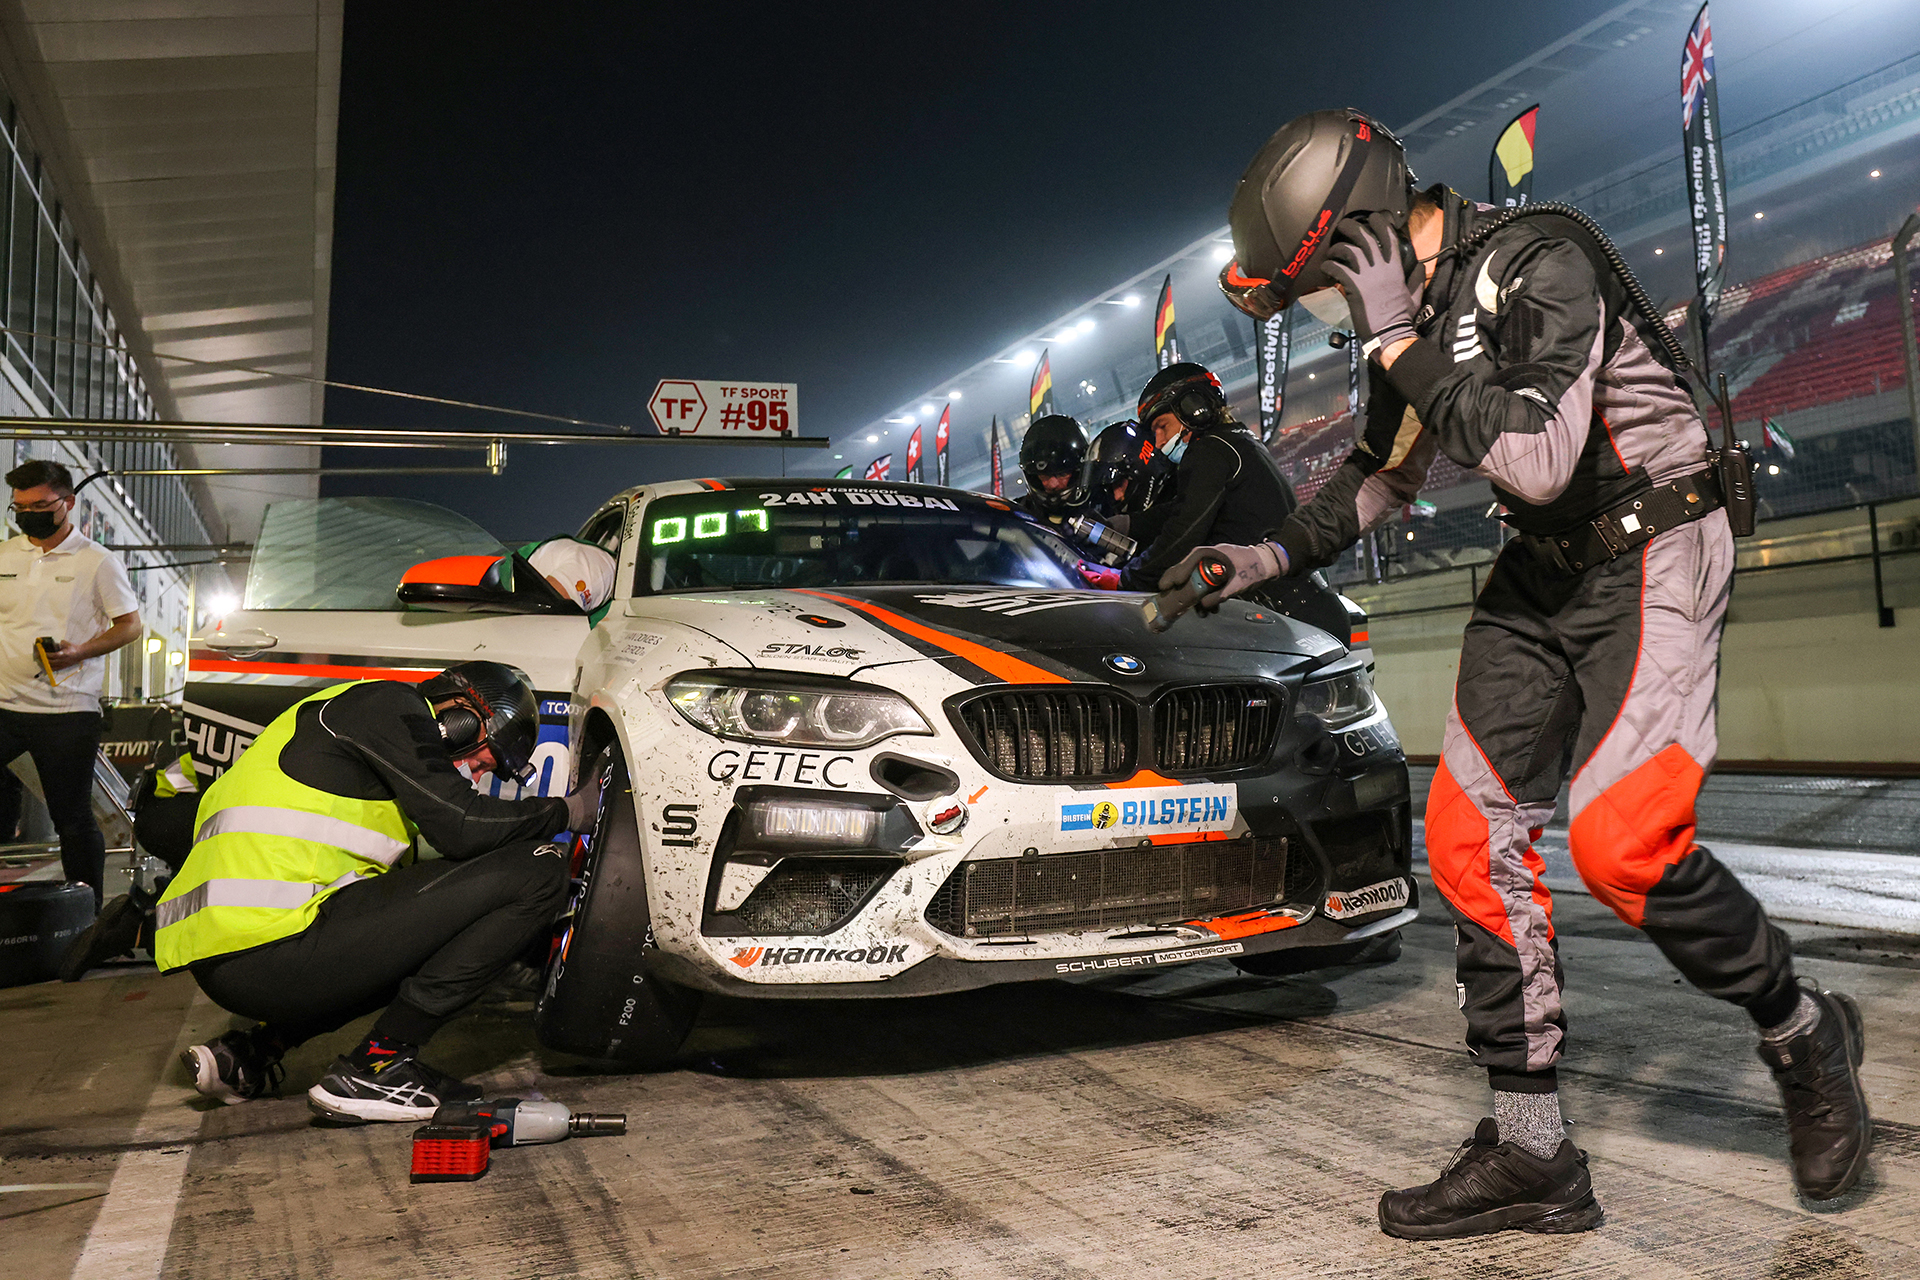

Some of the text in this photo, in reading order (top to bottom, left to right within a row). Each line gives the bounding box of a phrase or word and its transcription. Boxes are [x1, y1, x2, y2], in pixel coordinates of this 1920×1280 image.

[1706, 142, 1719, 181] Vantage
[1713, 182, 1724, 213] Martin
[1260, 312, 1283, 413] Racetivity
[720, 387, 788, 399] TF SPORT
[660, 398, 697, 419] TF
[720, 400, 789, 431] #95
[759, 492, 960, 511] 24H DUBAI
[707, 750, 854, 788] GETEC
[1062, 813, 1092, 823] BILSTEIN
[1122, 796, 1227, 825] BILSTEIN
[1055, 944, 1239, 974] SCHUBERT MOTORSPORT
[619, 998, 637, 1026] F200
